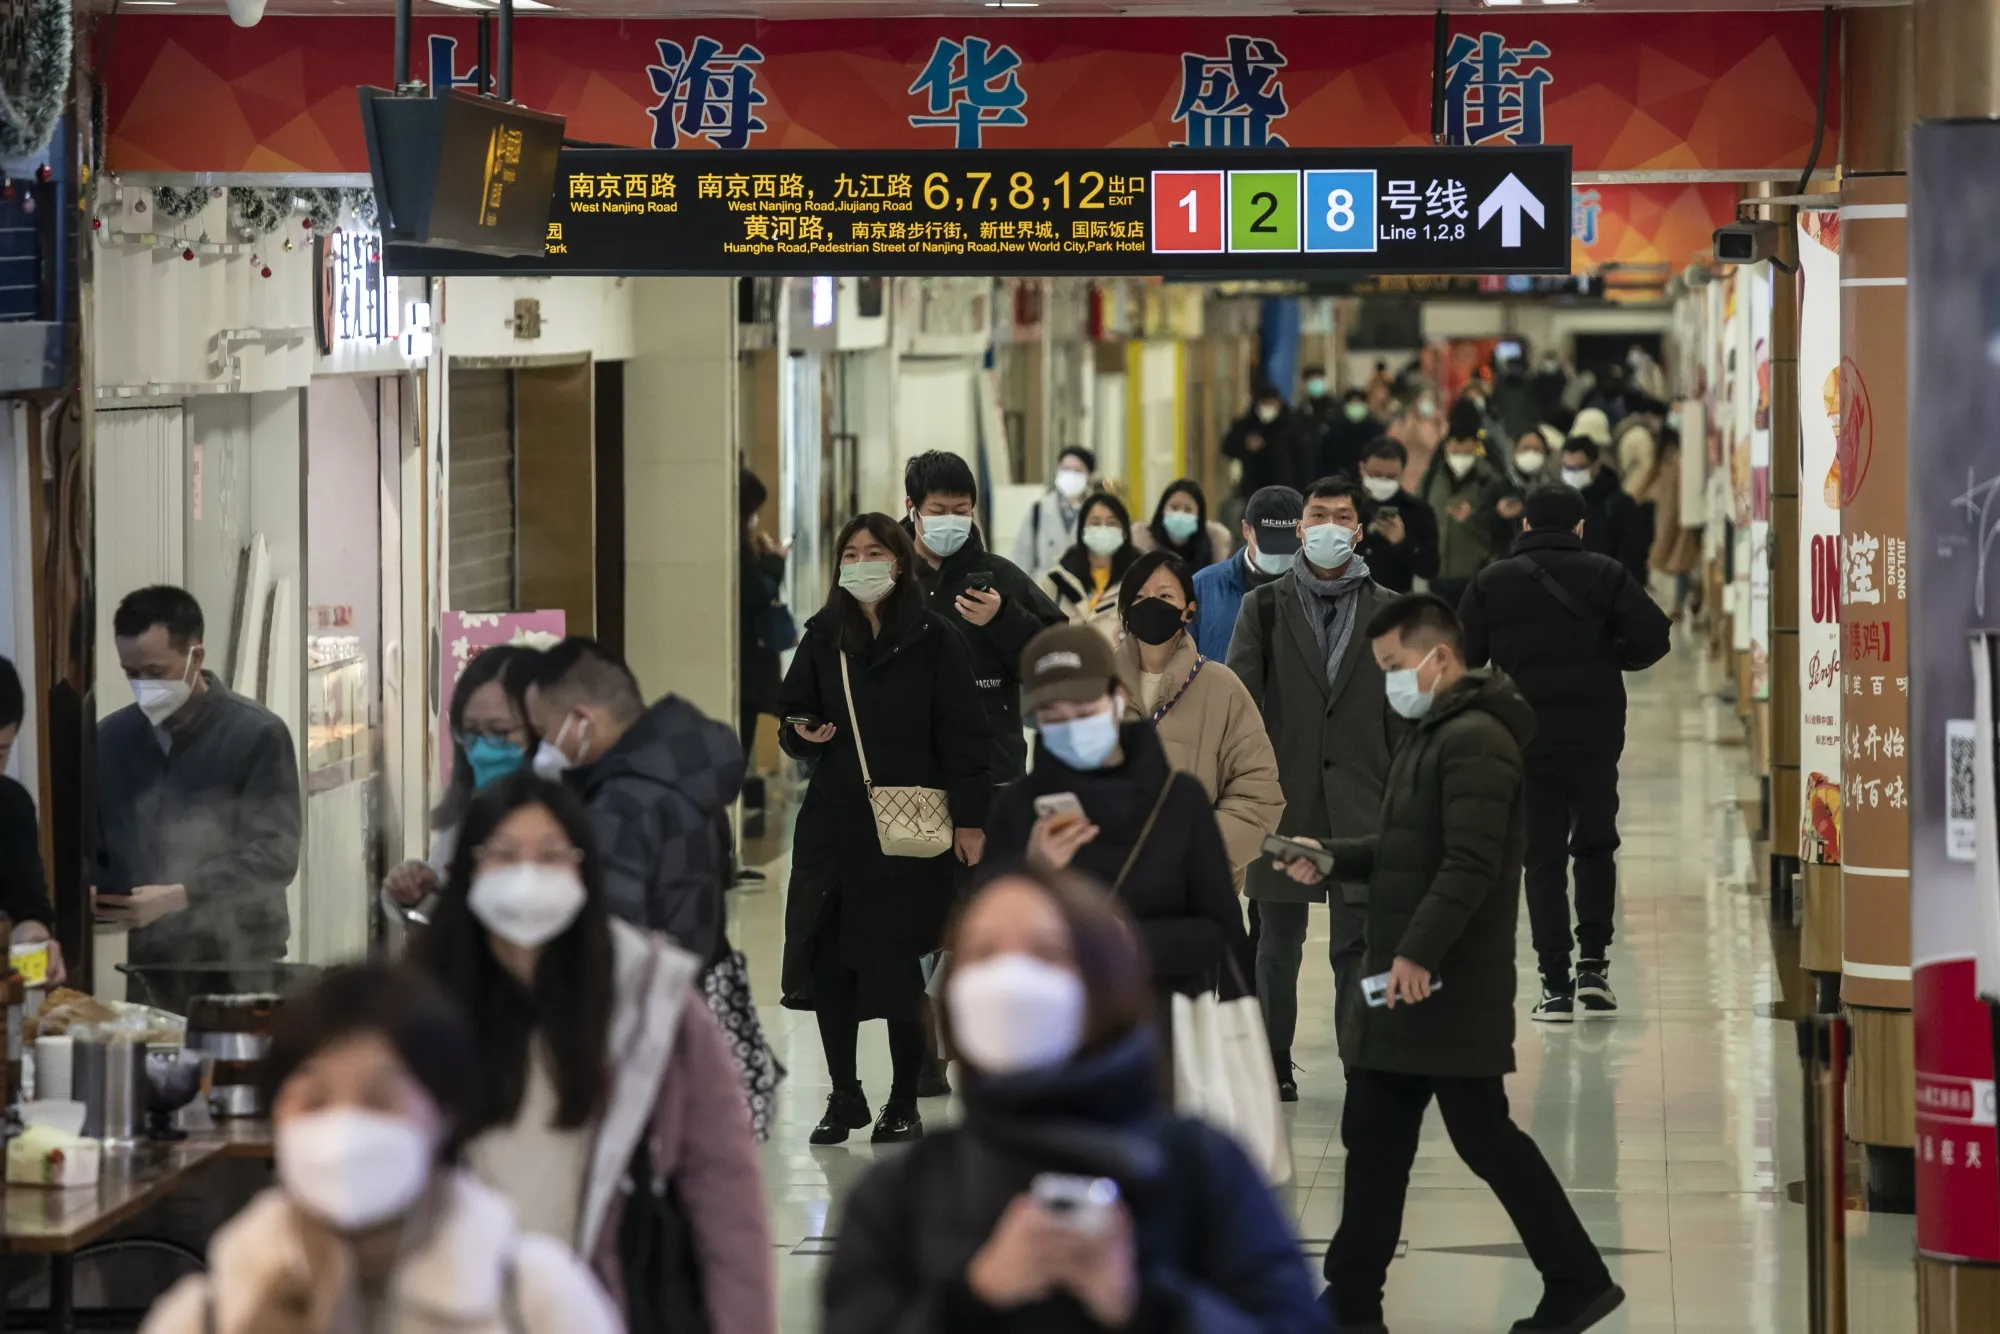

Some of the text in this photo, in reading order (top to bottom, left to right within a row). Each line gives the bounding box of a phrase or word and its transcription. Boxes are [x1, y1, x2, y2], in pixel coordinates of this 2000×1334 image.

[568, 172, 677, 199] 南京西路
[1108, 175, 1145, 194] 出口
[570, 201, 678, 215] West Nanjing Road
[727, 200, 757, 212] West
[759, 200, 802, 214] Nanjing
[882, 200, 913, 212] Road
[1108, 195, 1135, 206] EXIT
[1177, 179, 1469, 234] 1 2 8 号线
[1380, 223, 1465, 242] Line 1,2,8
[723, 241, 775, 255] Huanghe
[872, 241, 906, 253] Street
[908, 241, 920, 253] of
[922, 241, 965, 255] Nanjing
[1027, 241, 1061, 252] World
[1115, 240, 1145, 252] Hotel
[1887, 537, 1896, 586] SHENG
[1897, 537, 1906, 600] JIULONG
